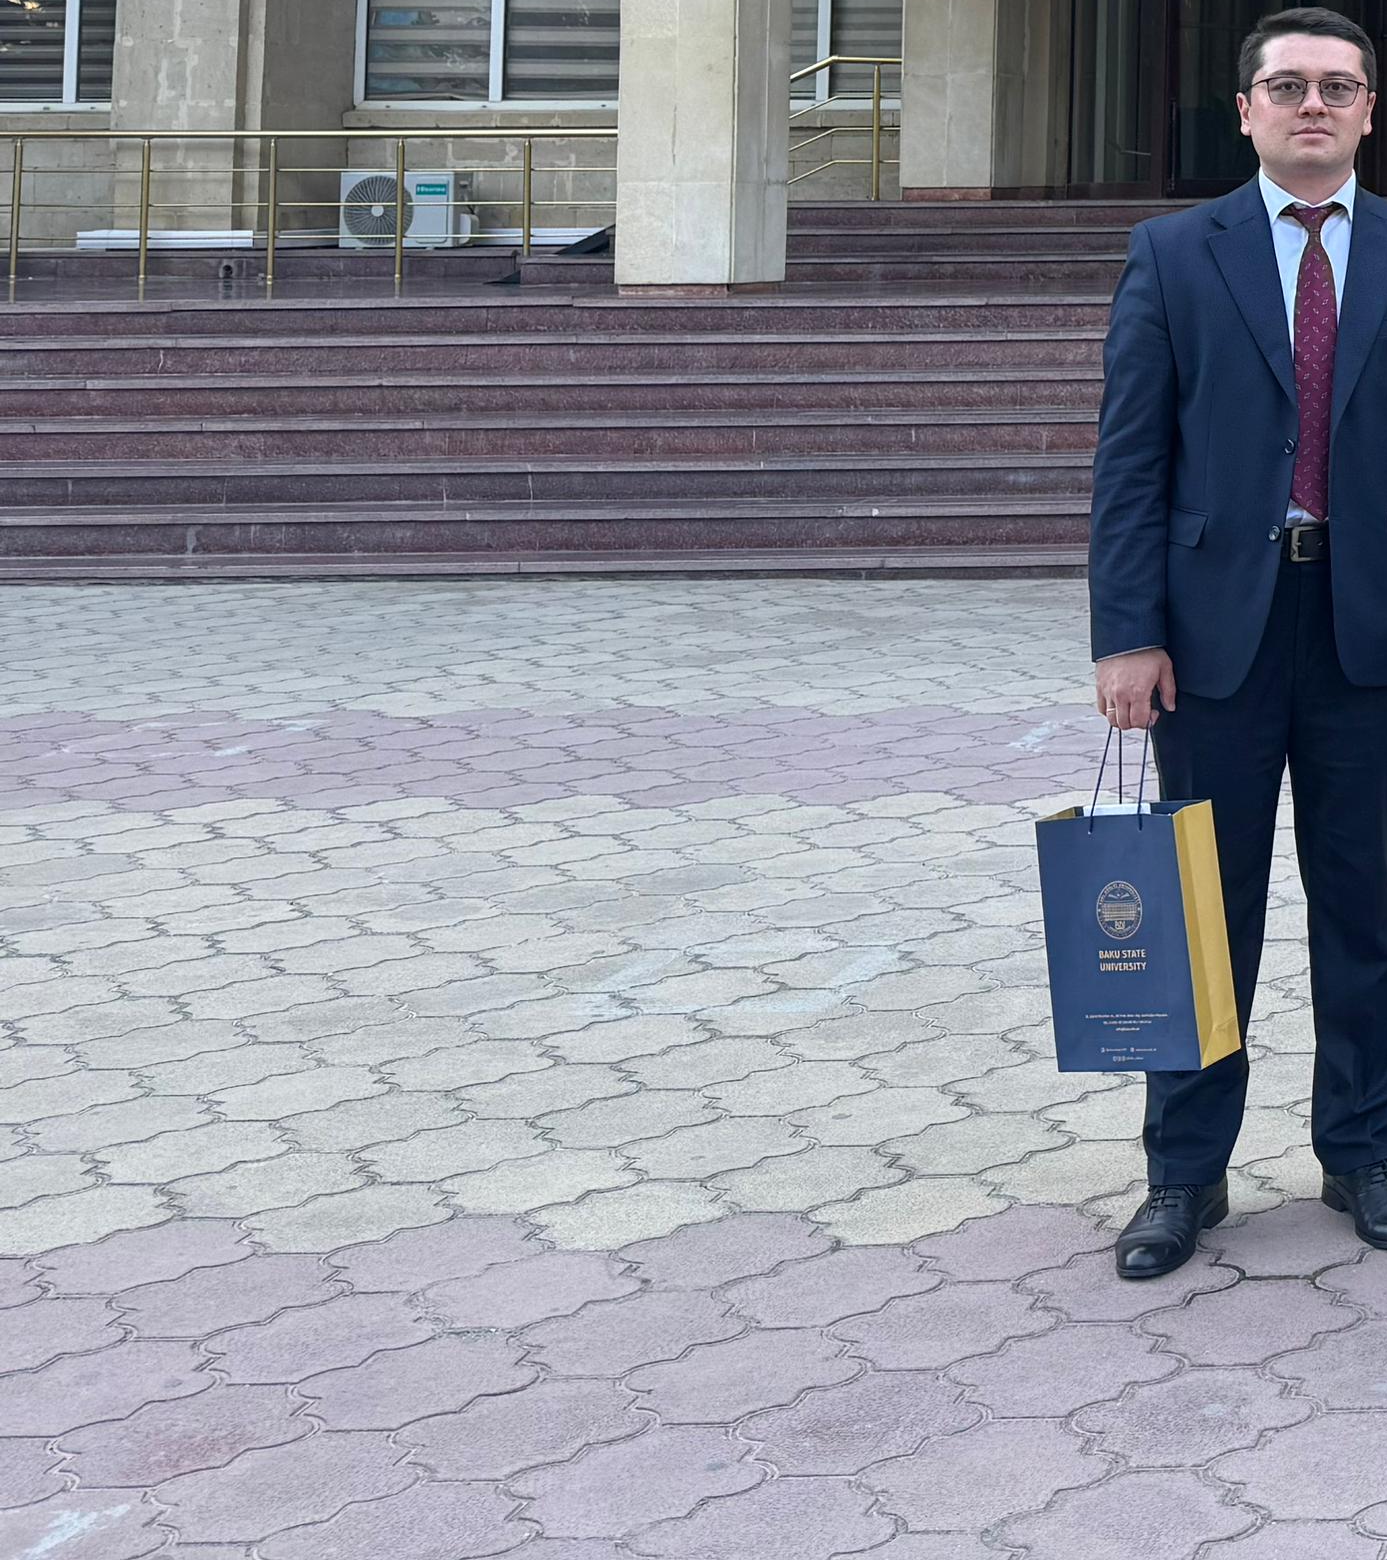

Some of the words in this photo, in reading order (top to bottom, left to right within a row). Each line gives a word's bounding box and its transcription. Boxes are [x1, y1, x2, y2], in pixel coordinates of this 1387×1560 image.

[1099, 950, 1120, 959] BAKU
[1120, 948, 1147, 959] STATE
[1100, 961, 1147, 972] UNIVERSITY
